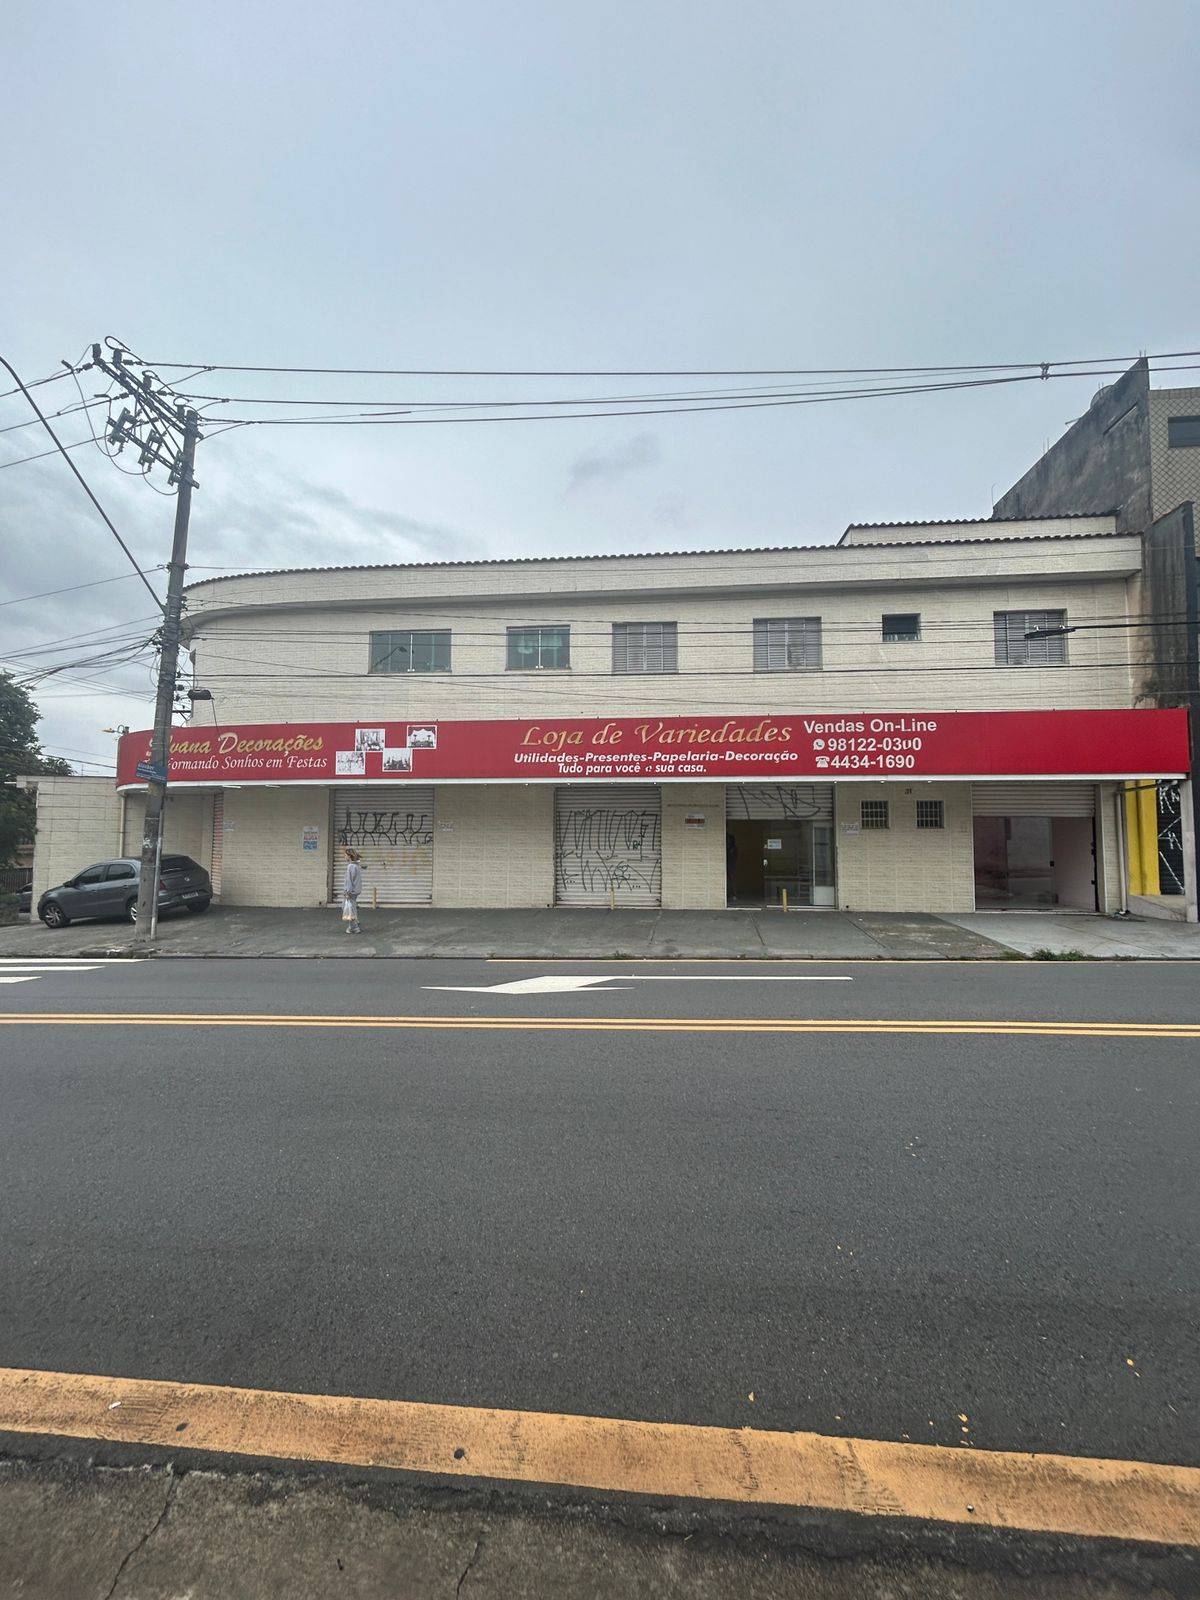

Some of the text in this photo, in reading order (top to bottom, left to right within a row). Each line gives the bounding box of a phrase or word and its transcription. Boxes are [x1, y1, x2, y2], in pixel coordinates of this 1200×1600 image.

[803, 718, 938, 734] Vendas On-Line
[520, 719, 793, 752] Loja de Variedades
[146, 732, 324, 757] vana Decorações
[221, 754, 264, 770] Sonhos
[266, 758, 283, 768] em
[286, 755, 328, 769] Festas
[558, 763, 583, 774] Tudo
[585, 764, 612, 776] para
[615, 762, 641, 773] você
[655, 764, 675, 773] sua
[678, 763, 707, 773] casa.
[830, 754, 916, 769] 4434-1690
